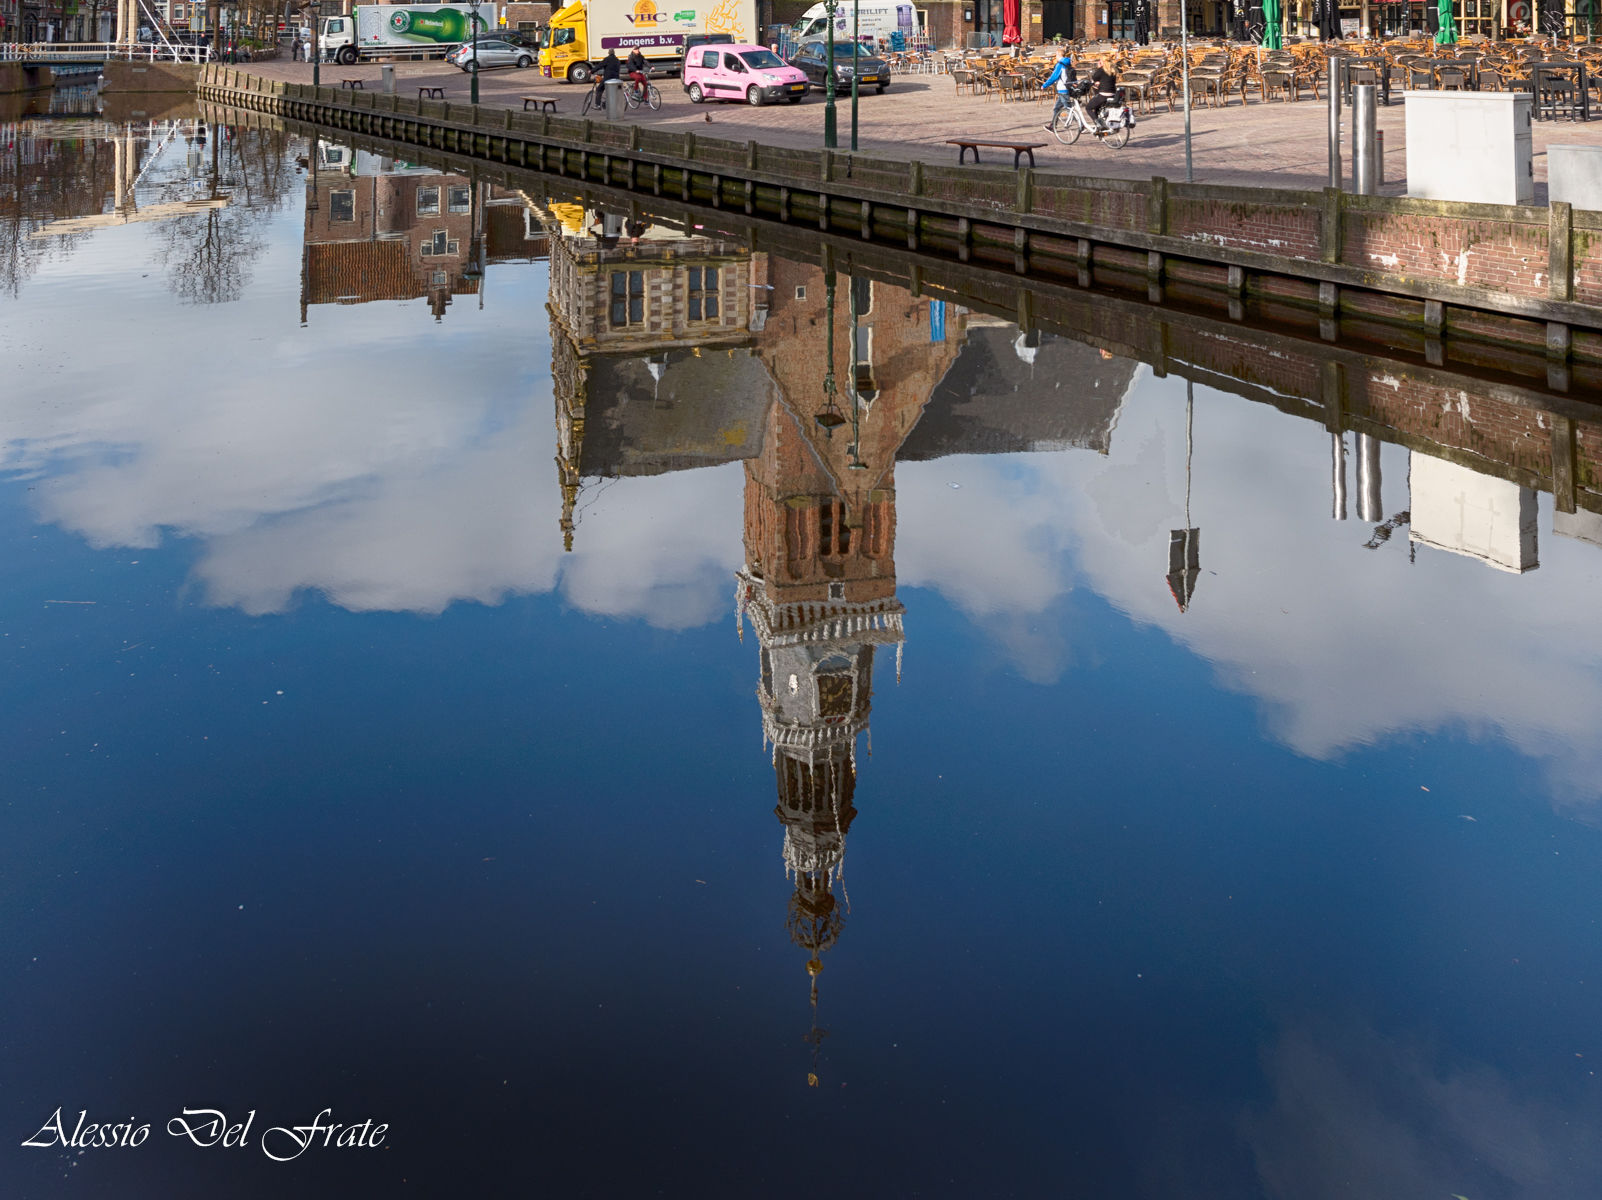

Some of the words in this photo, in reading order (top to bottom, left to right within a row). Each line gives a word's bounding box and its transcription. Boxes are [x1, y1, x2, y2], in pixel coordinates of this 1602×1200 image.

[624, 12, 668, 24] VHC
[618, 38, 655, 47] Jongens
[659, 36, 675, 45] b.v.
